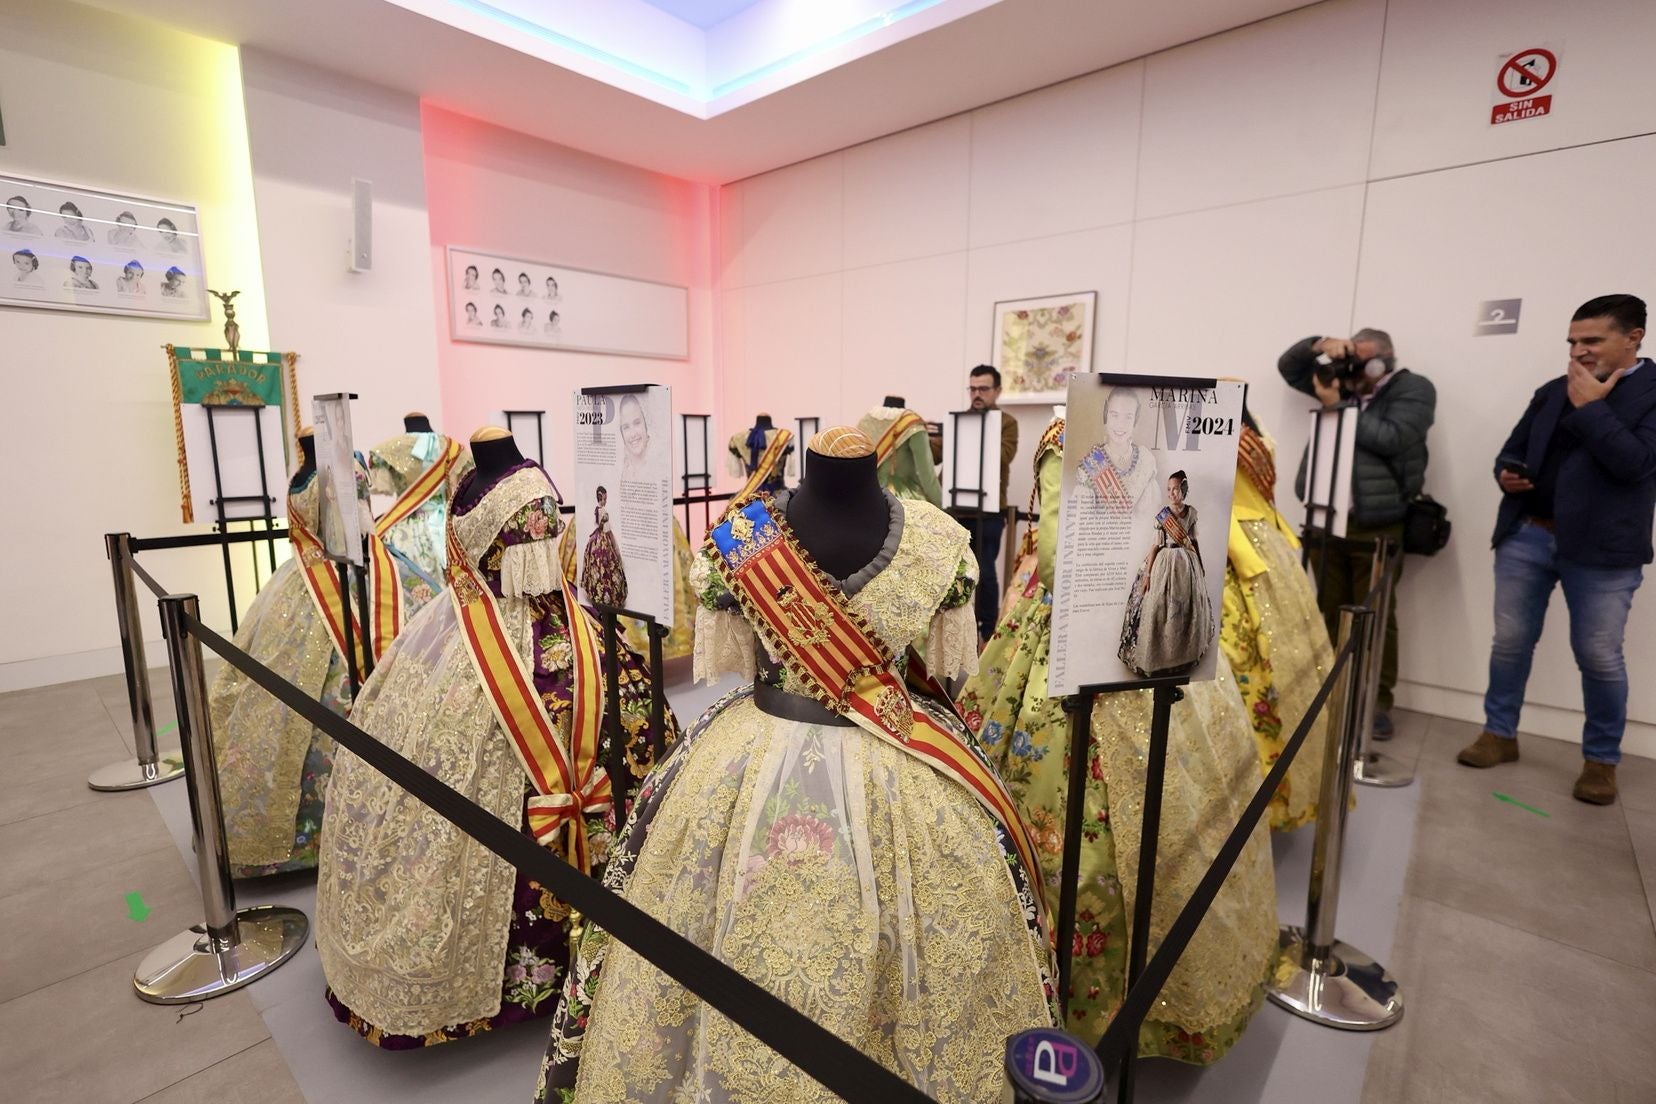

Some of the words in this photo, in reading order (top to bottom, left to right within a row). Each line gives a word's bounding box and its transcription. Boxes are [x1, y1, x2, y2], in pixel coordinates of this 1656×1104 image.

[1509, 99, 1533, 112] SIN
[1494, 106, 1545, 124] SALIDA
[1490, 308, 1506, 324] 2
[196, 364, 267, 384] PARADOR
[576, 393, 606, 406] PAULA
[1150, 387, 1218, 404] MARINA
[579, 411, 604, 425] 2023
[1191, 416, 1235, 436] 2024
[1063, 494, 1078, 566] INFANTIL
[1058, 568, 1073, 620] MAYOR
[1053, 623, 1069, 689] FALLERA
